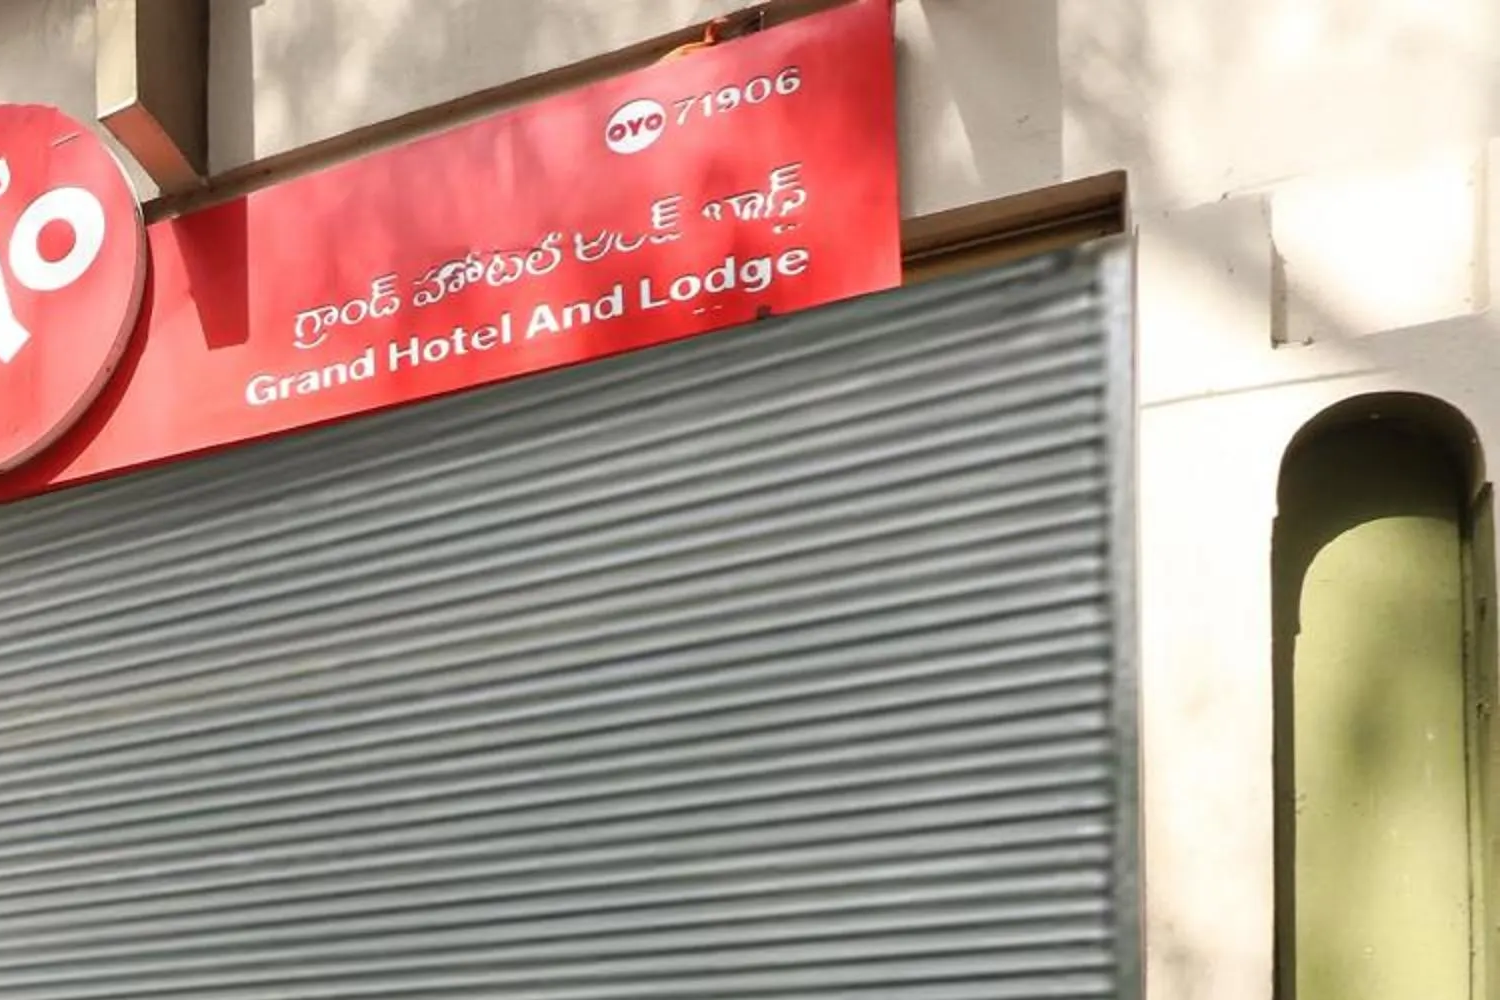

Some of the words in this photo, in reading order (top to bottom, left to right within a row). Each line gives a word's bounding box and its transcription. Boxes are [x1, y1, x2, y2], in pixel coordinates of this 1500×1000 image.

[608, 113, 663, 142] OYO
[672, 66, 801, 126] 71906
[245, 347, 375, 407] Grand
[389, 312, 512, 374] Hotel
[525, 289, 623, 339] And
[640, 248, 810, 310] Lodge
